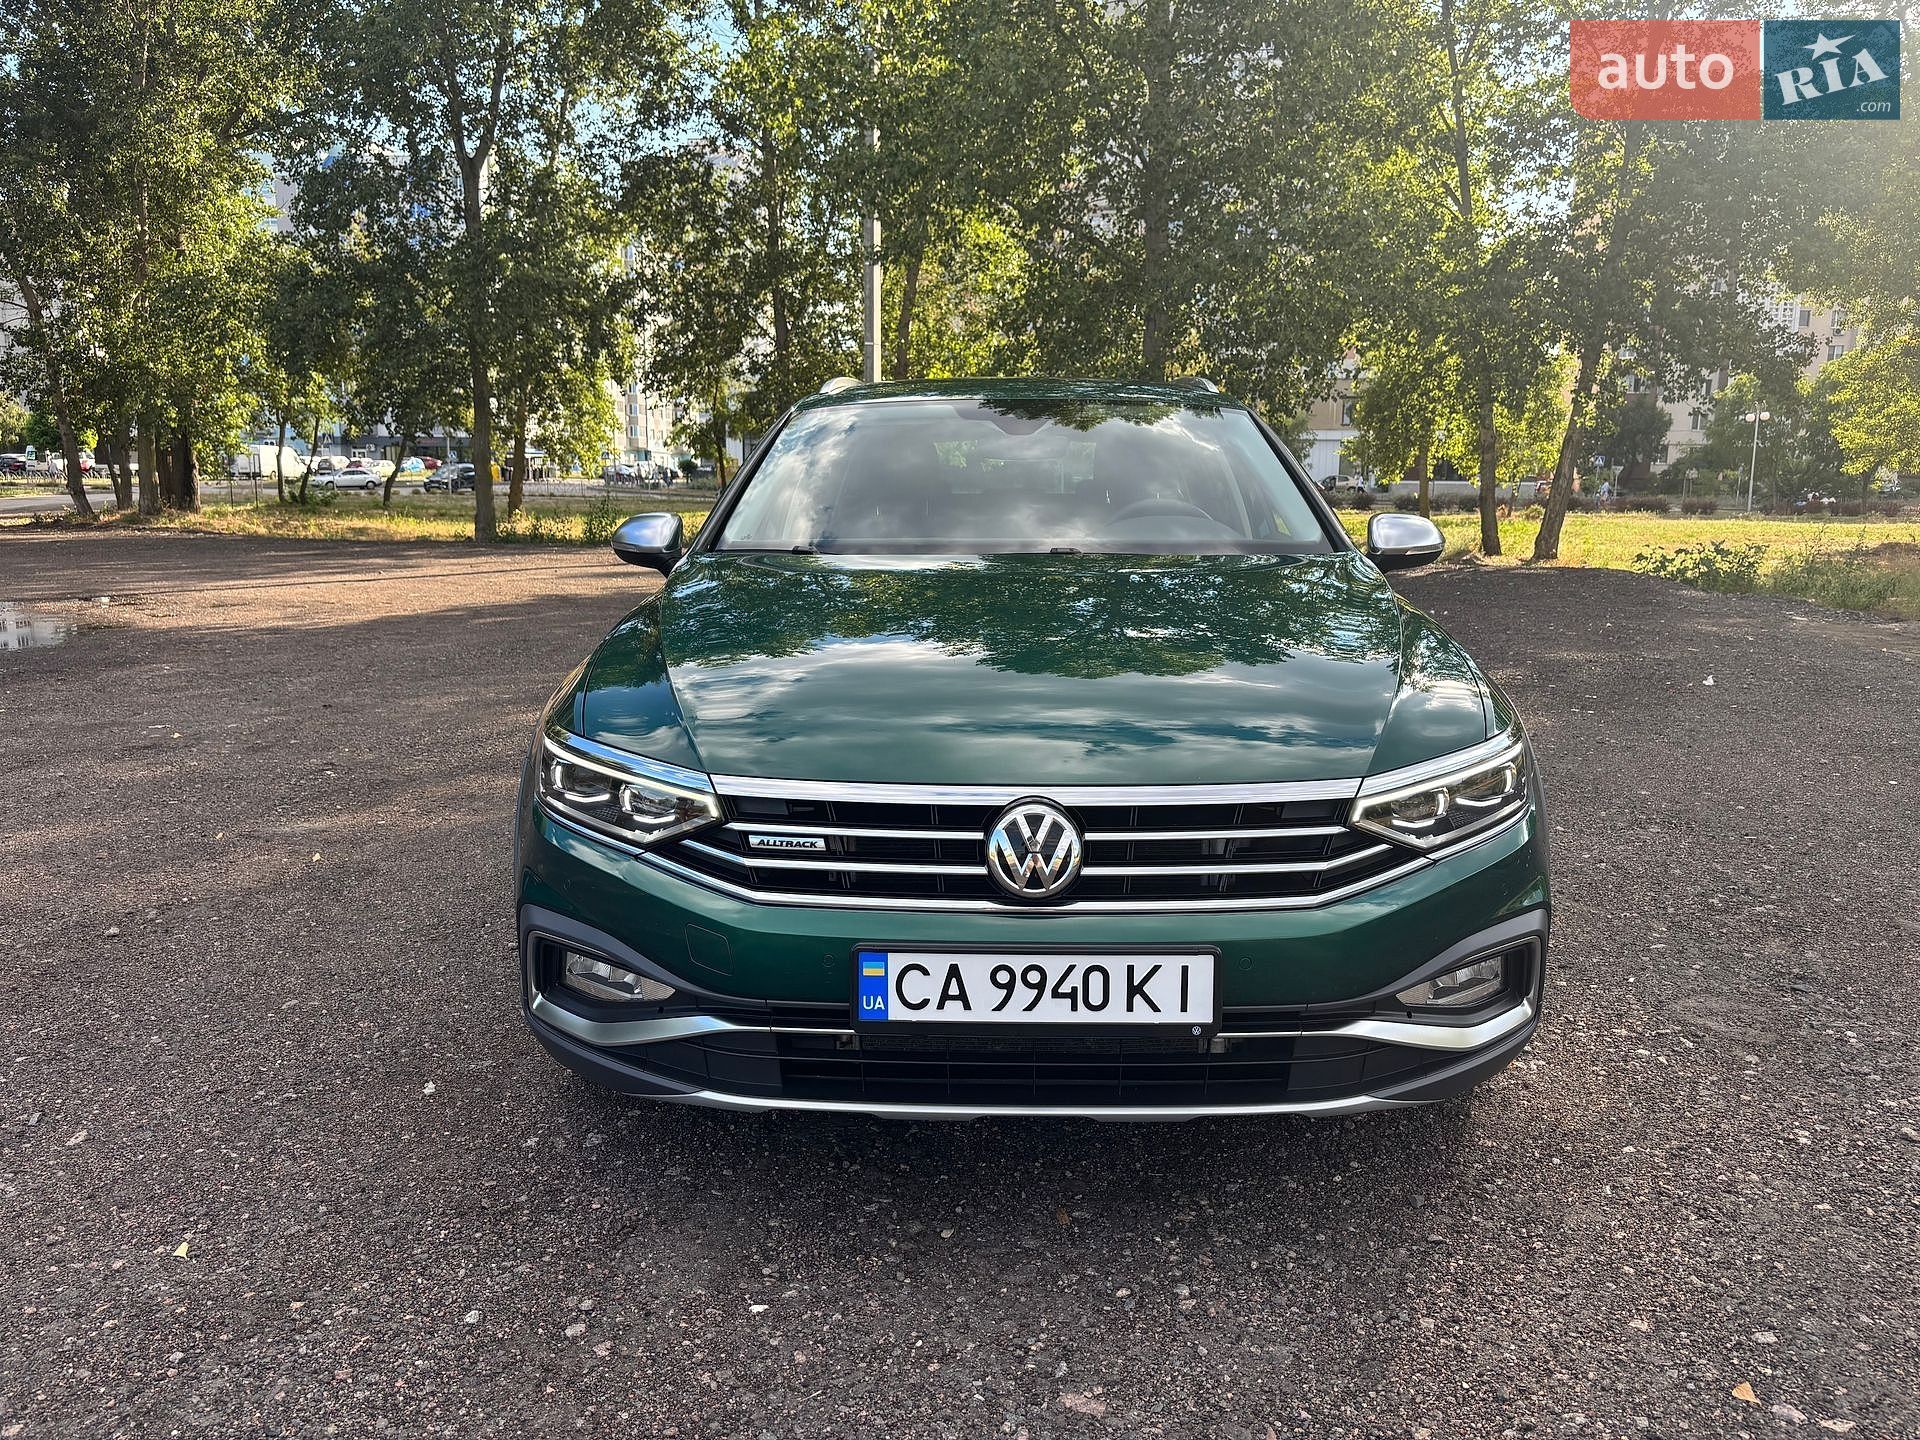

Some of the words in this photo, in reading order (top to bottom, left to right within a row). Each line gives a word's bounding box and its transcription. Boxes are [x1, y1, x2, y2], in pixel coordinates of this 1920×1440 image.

[757, 838, 818, 849] ALLTRACK
[895, 963, 972, 1011] CA
[989, 964, 1110, 1012] 9940
[863, 996, 885, 1010] UA
